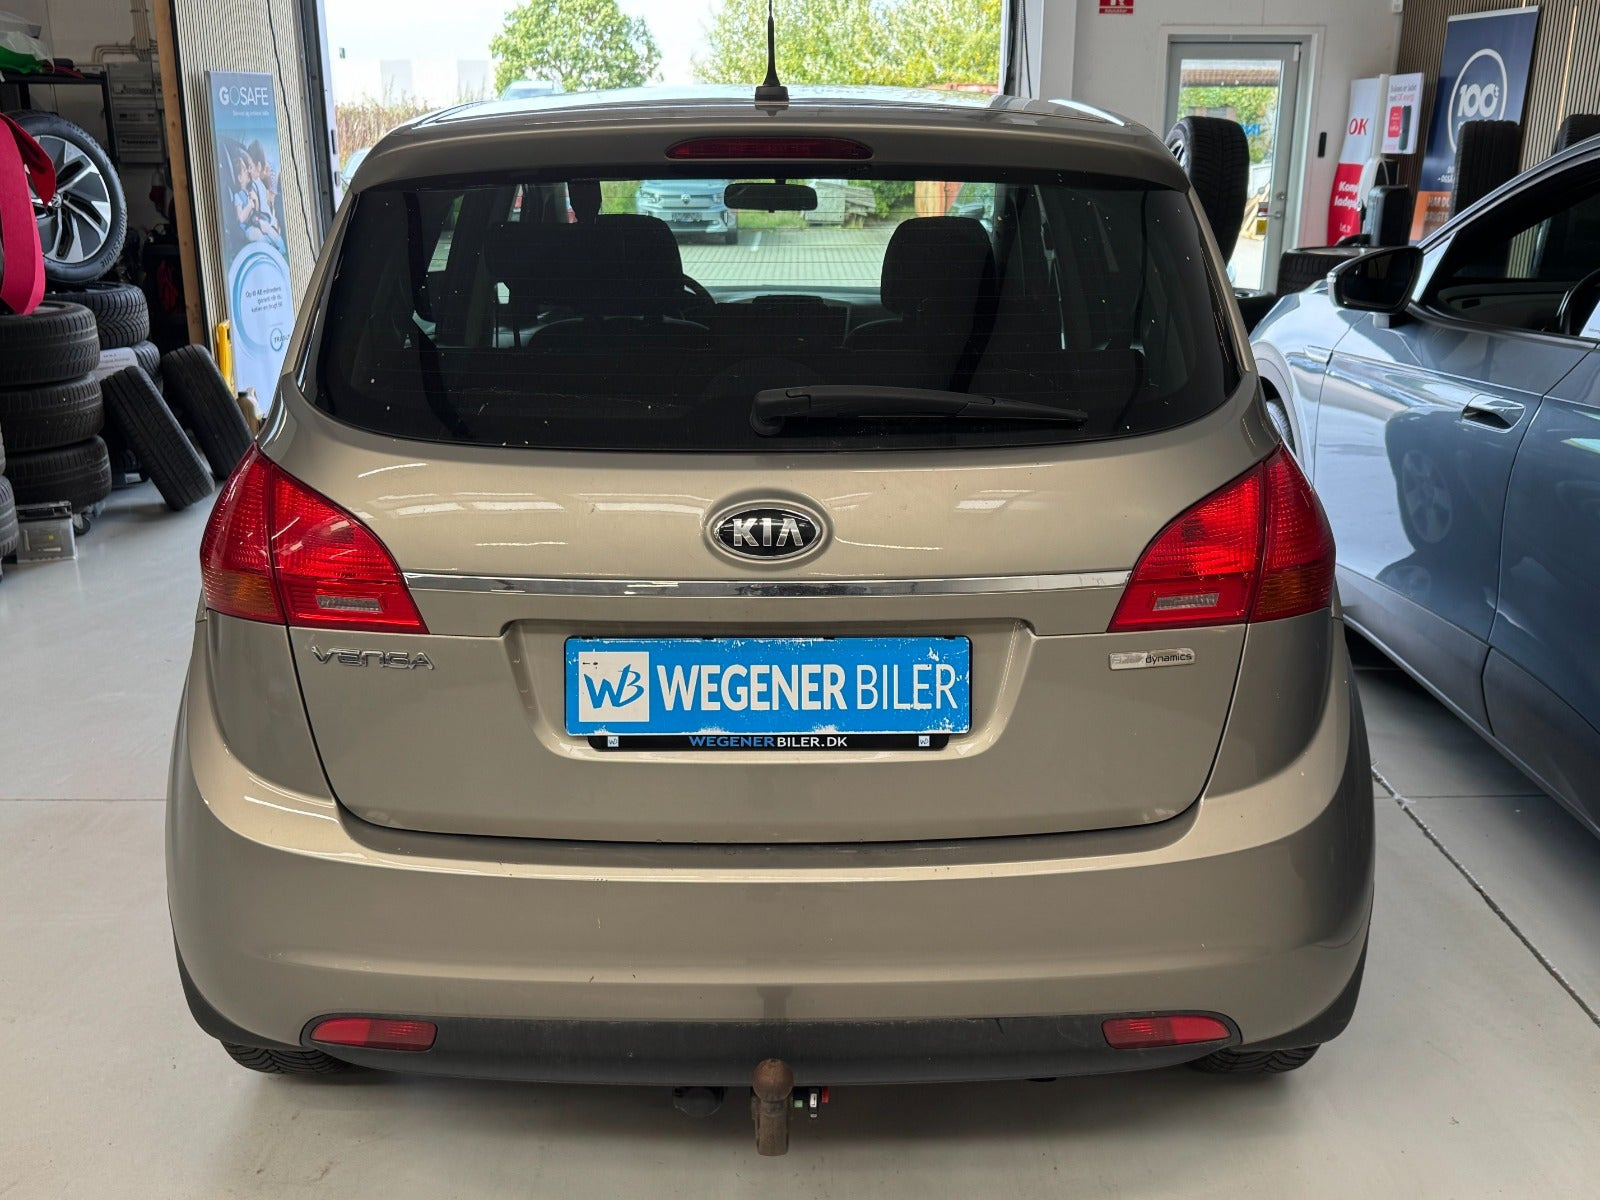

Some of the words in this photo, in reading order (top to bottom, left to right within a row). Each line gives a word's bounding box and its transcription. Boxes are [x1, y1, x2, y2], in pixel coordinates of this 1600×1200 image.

[219, 86, 269, 106] GOSAFE
[1349, 118, 1369, 135] OK
[733, 518, 804, 547] KIA
[1145, 653, 1193, 665] dynamics
[583, 664, 645, 709] WB
[657, 664, 847, 711] WEGENER
[857, 663, 958, 710] BILER
[689, 736, 848, 747] WEGENERBILER.DK
